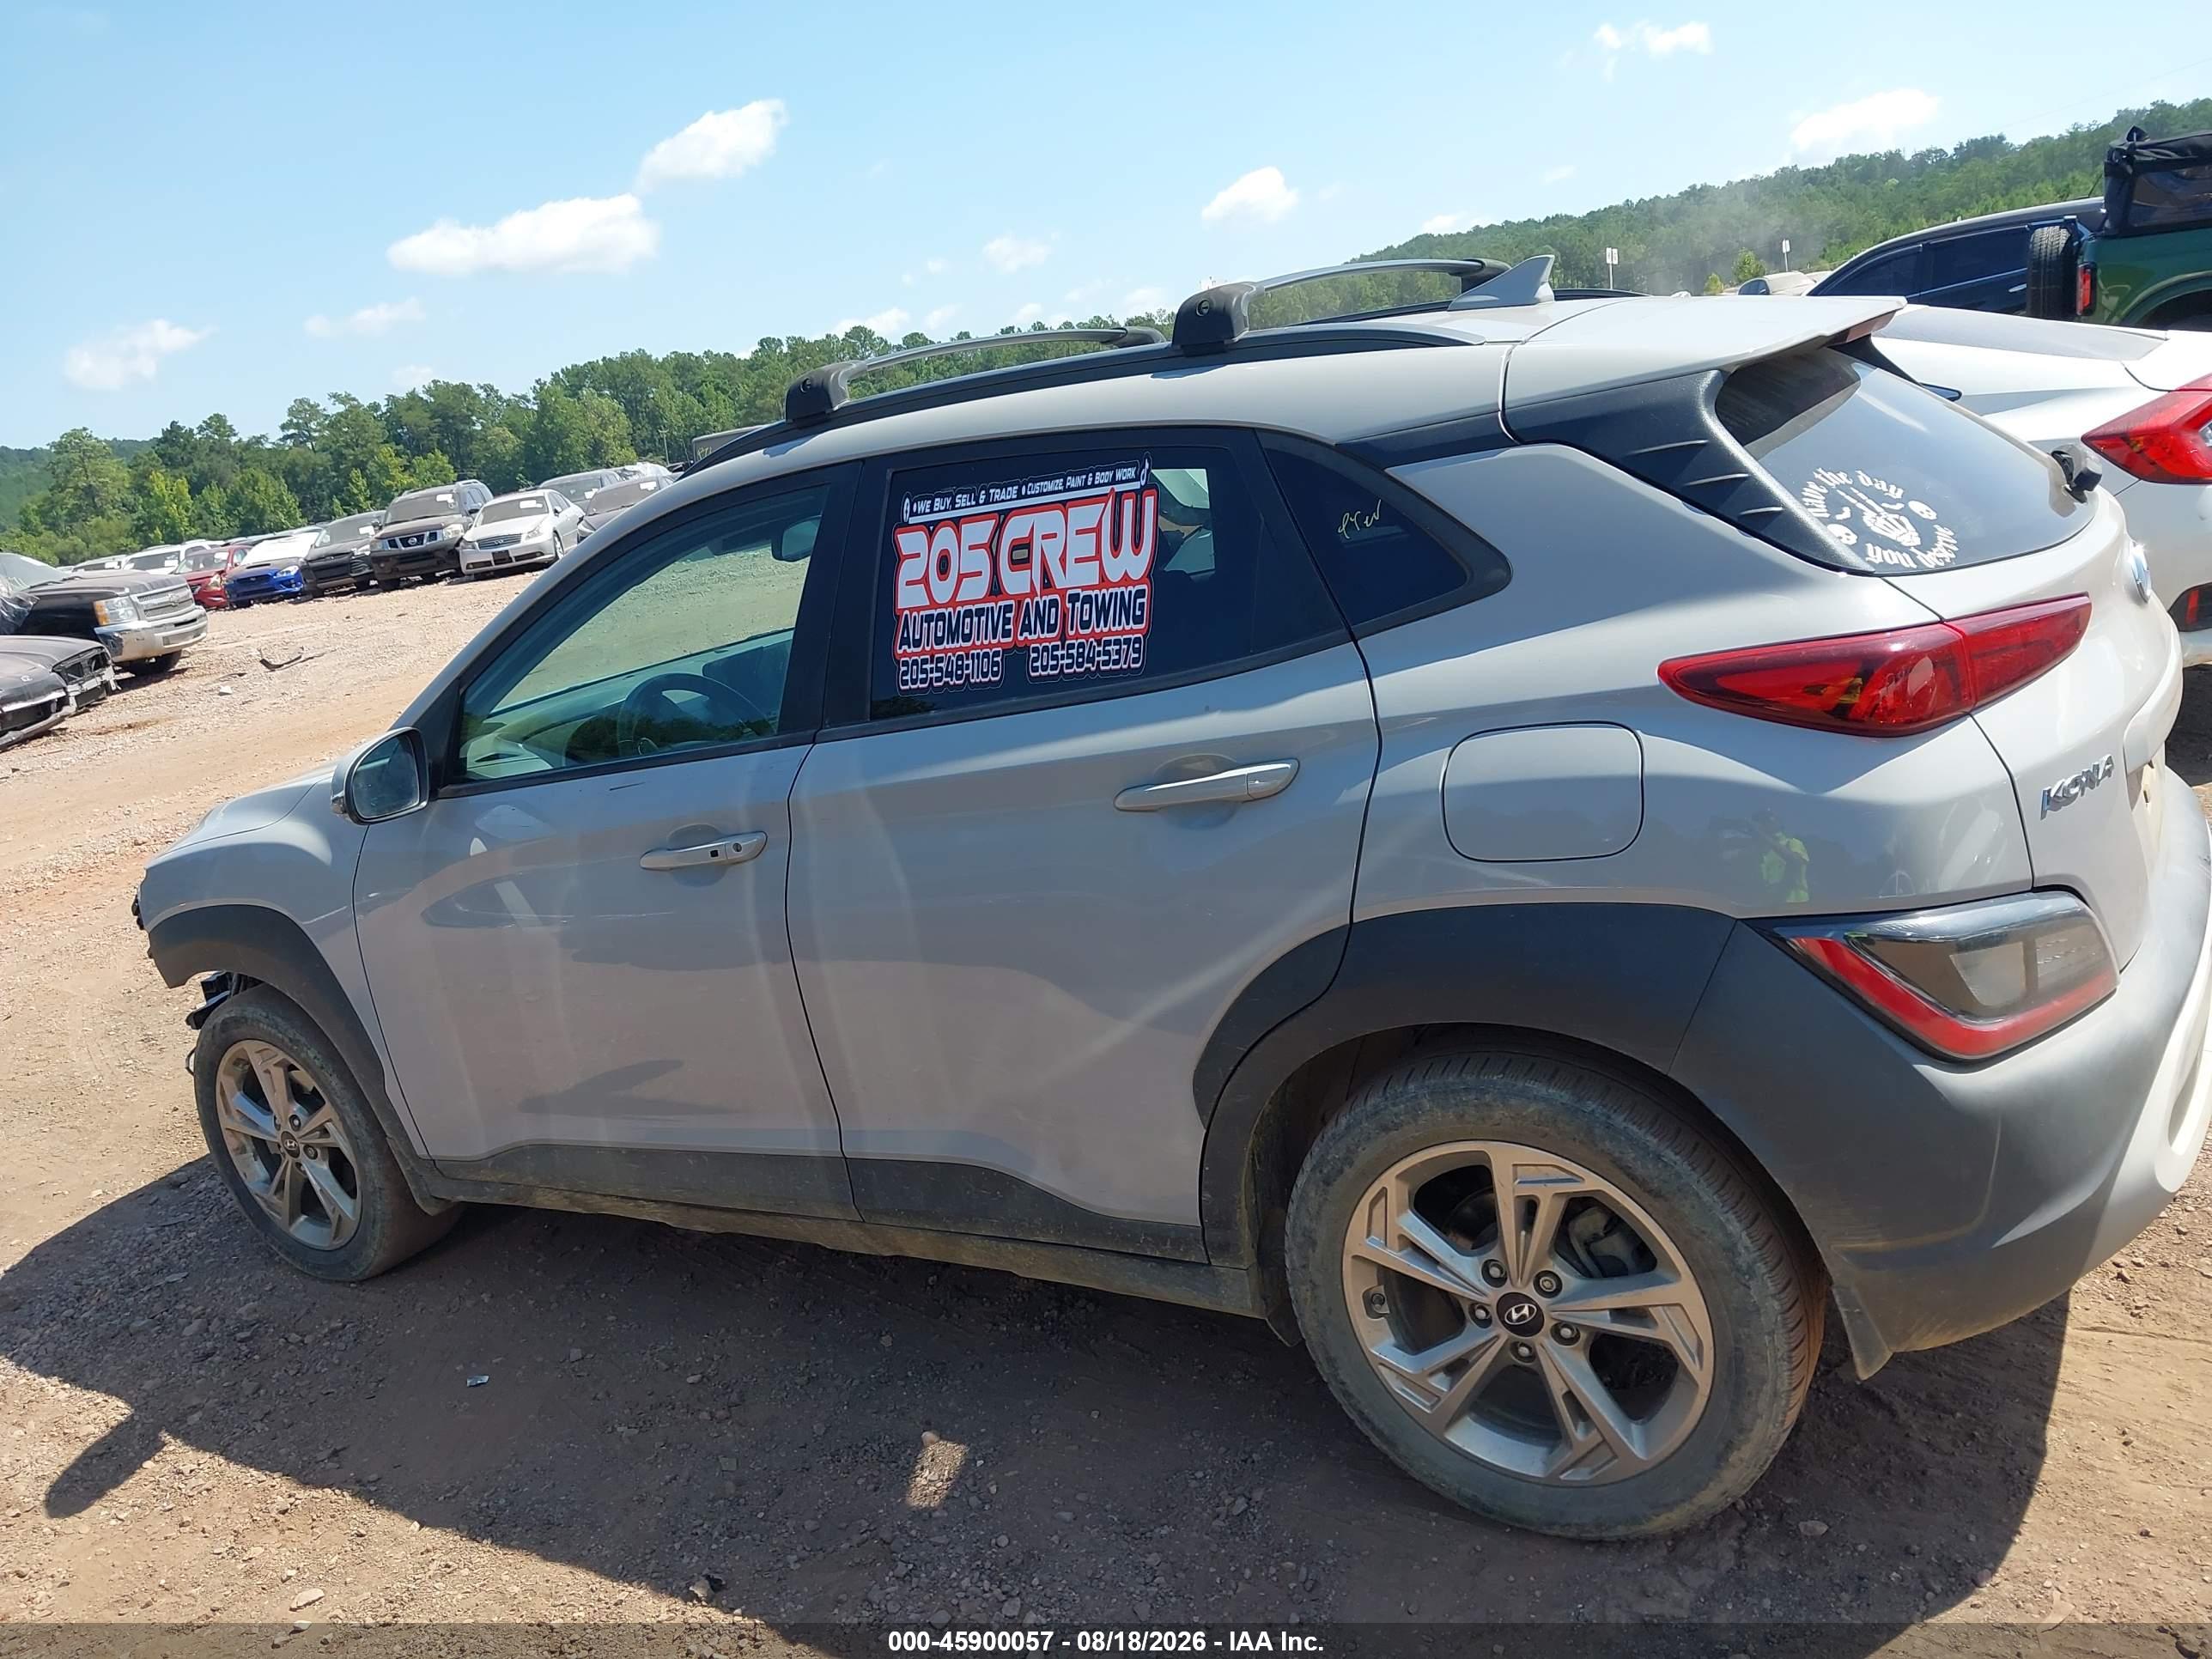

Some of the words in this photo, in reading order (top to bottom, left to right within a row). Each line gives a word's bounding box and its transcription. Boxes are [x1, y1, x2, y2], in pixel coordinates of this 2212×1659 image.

[917, 499, 932, 514] WE
[933, 495, 952, 511] BUY,
[954, 492, 976, 508] SELL
[978, 490, 987, 504] &
[988, 484, 1019, 502] TRADE
[1066, 473, 1086, 489] PAINT
[1086, 472, 1093, 486] &
[1094, 470, 1115, 485] BODY
[1115, 465, 1138, 482] WORK
[896, 517, 997, 611] 205
[998, 490, 1157, 599] CREW
[897, 600, 1015, 653] AUTOMOTIVE
[1017, 597, 1062, 641] AND
[1066, 586, 1148, 635] TOWING
[899, 647, 1003, 690] 205-548-1106
[1030, 634, 1144, 677] 205-584-5379
[2039, 753, 2115, 822] KONA
